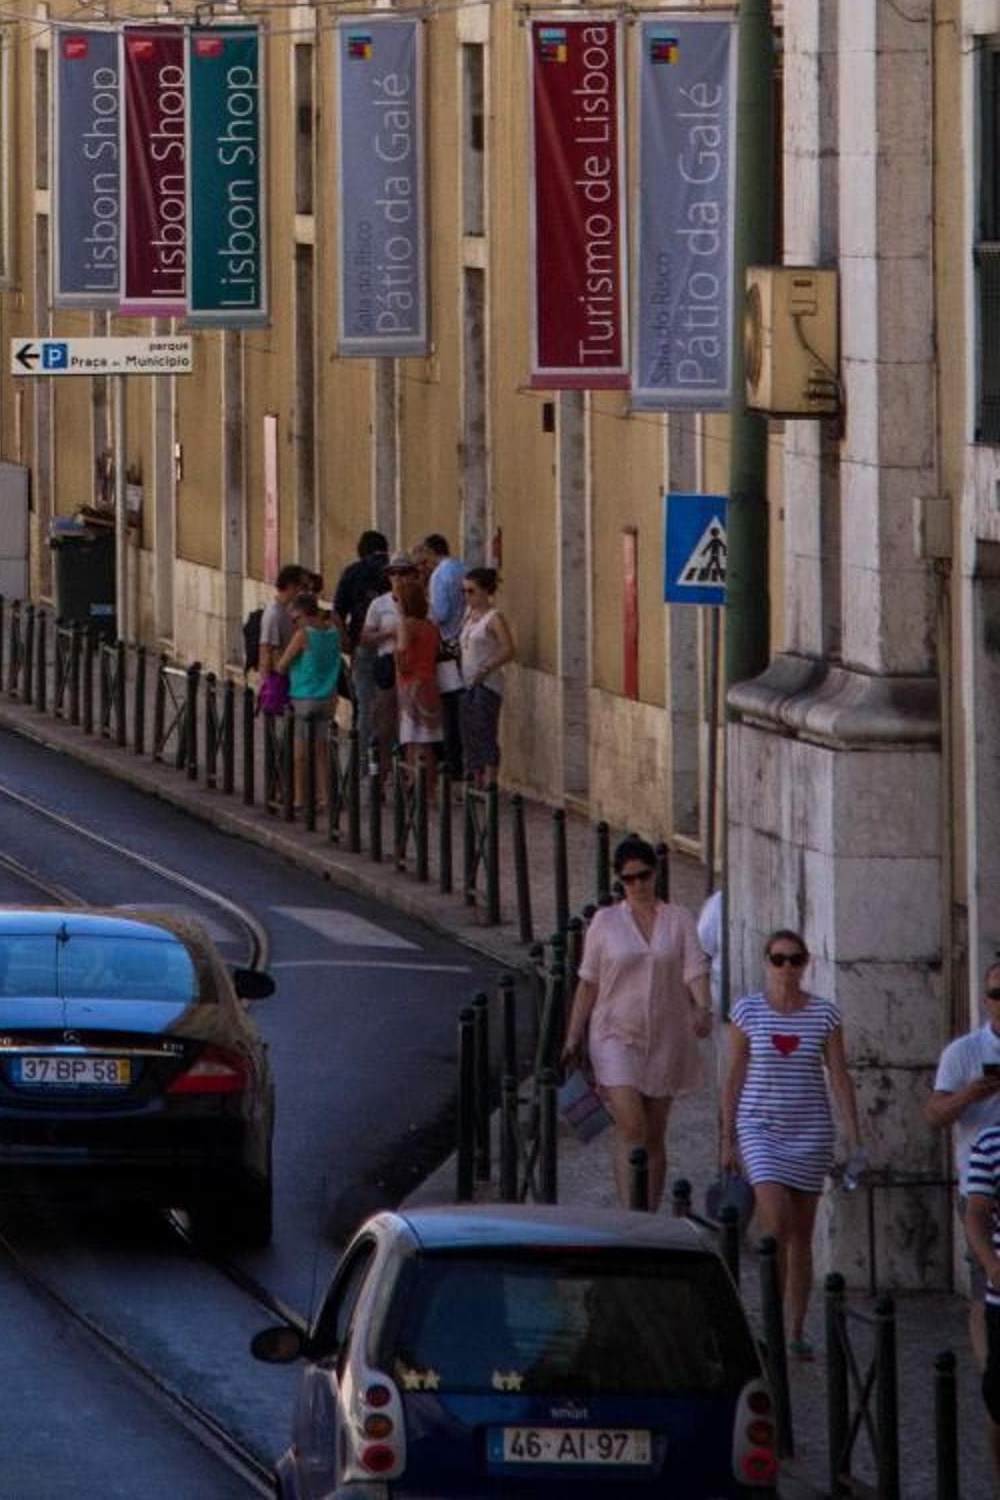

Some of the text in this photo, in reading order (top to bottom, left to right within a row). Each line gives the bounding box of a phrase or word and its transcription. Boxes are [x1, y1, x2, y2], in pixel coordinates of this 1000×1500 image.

[83, 68, 120, 289] Lisbon Shop
[150, 65, 185, 294] Lisbon Shop
[217, 66, 260, 306] Lisbon Shop
[372, 73, 413, 333] Pátio da Galé
[572, 27, 616, 364] Turismo de Lisboa
[675, 83, 723, 384] Pátio da Galé
[150, 343, 188, 351] parque
